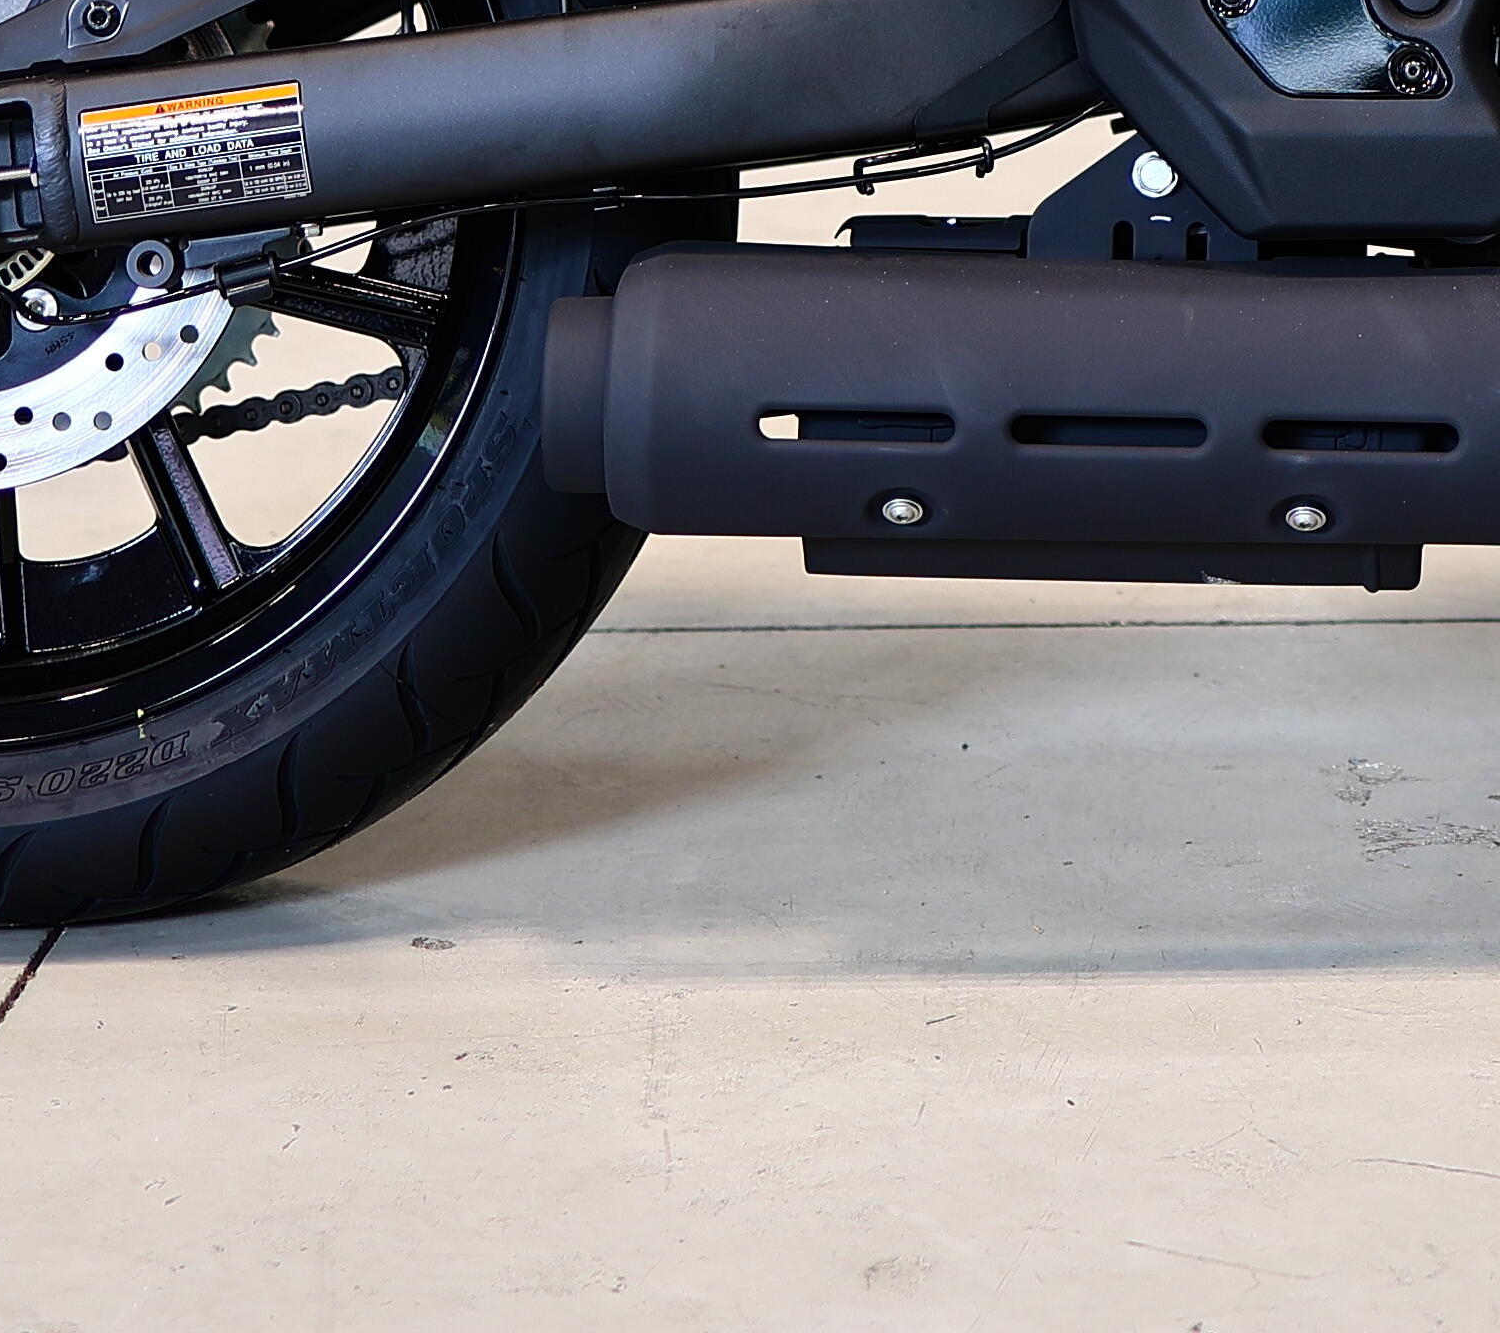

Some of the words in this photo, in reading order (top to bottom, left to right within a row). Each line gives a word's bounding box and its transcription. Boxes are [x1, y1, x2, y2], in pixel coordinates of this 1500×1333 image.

[167, 96, 225, 113] WARNING
[134, 152, 160, 164] TIRE
[165, 147, 187, 160] AND
[193, 143, 223, 155] LOAD
[227, 138, 255, 151] DATA
[34, 729, 191, 798] D220
